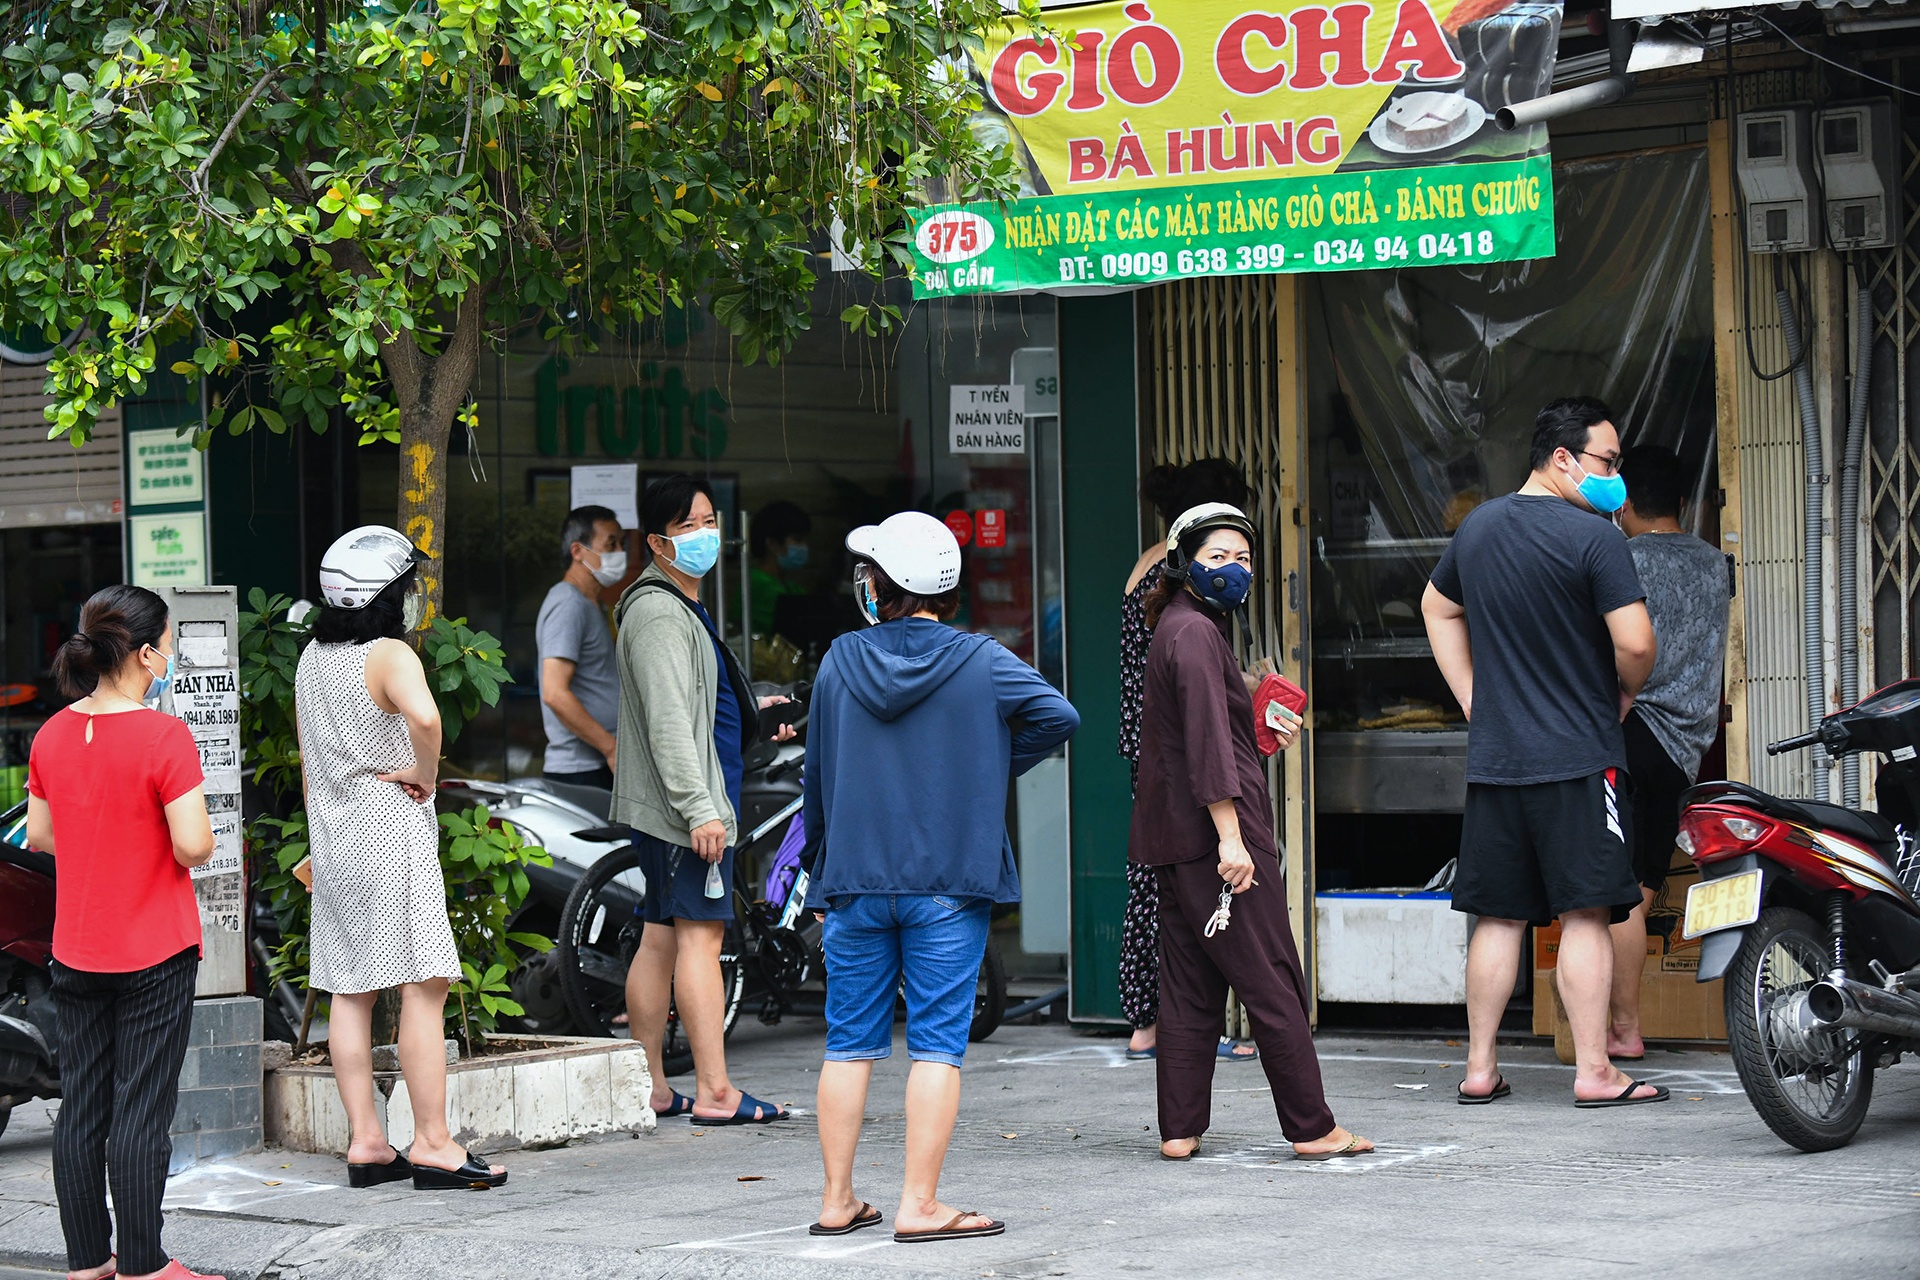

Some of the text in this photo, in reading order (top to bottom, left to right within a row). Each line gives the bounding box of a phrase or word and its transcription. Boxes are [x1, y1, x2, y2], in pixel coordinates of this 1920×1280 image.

[991, 3, 1182, 117] GIÒ
[1067, 109, 1341, 184] BÀ HÙNG
[1004, 205, 1061, 256] NHẬN
[1065, 200, 1111, 252] ĐẶT
[1116, 197, 1160, 241] CÁC
[1165, 192, 1212, 246] MẶT
[1217, 190, 1279, 235] HÀNG
[1285, 184, 1324, 229] GIÒ
[1330, 176, 1379, 226] CHẢ
[1397, 176, 1465, 222] BÁNH
[1471, 173, 1541, 217] CHƯNG
[928, 220, 978, 255] 375
[1059, 256, 1095, 281] ĐT:
[1101, 251, 1168, 278] 0909
[1177, 248, 1228, 274] 638
[1235, 244, 1285, 271] 399
[1313, 239, 1365, 265] 034
[1374, 236, 1409, 262] 94
[1418, 230, 1494, 259] 0418
[953, 259, 995, 288] CẤN
[535, 354, 729, 459] fruits
[994, 409, 1023, 425] VIÊN
[956, 431, 1022, 448] BÁN HÀNG
[174, 671, 236, 694] BÁN NHÀ
